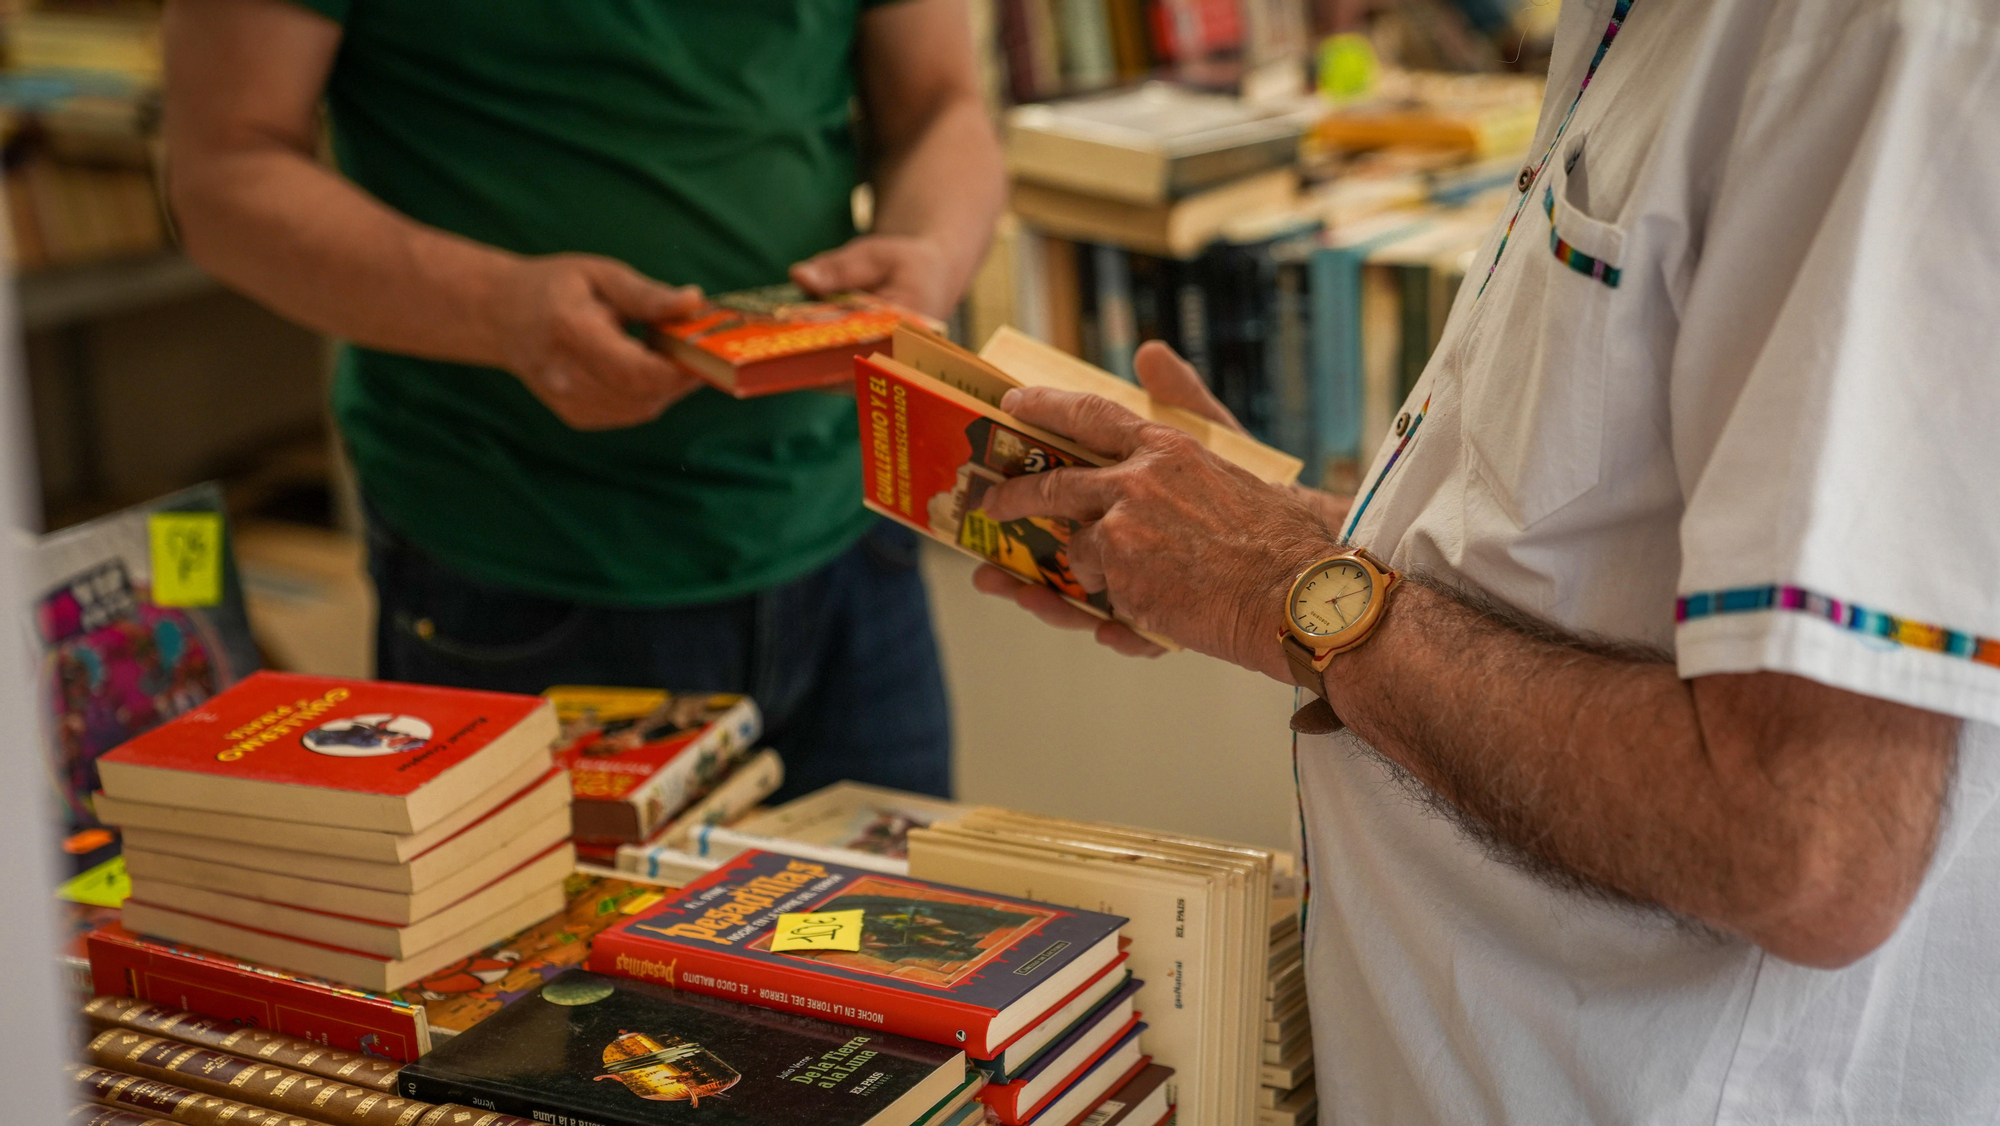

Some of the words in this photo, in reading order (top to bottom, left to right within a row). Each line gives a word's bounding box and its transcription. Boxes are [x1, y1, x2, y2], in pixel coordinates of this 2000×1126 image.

[869, 375, 888, 397] EL
[870, 394, 888, 409] Y
[893, 385, 910, 479] ENMASCARADO
[872, 411, 894, 505] GUILLERMO
[215, 687, 350, 762] GUILLERMO
[726, 924, 760, 942] NOCHE
[752, 916, 771, 928] EN
[773, 899, 804, 914] TORRE
[796, 890, 818, 902] DEL
[810, 873, 844, 893] TERROR
[1176, 898, 1186, 924] PAIS
[1175, 925, 1185, 938] EL
[682, 972, 715, 988] MALDITO
[716, 979, 738, 992] CUCO
[738, 983, 749, 994] EL
[759, 988, 789, 1003] TERROR
[791, 995, 805, 1007] DEL
[807, 999, 832, 1013] TORRE
[833, 1004, 844, 1014] LA
[844, 1007, 856, 1018] EN
[857, 1009, 884, 1024] NOCHE
[821, 1036, 871, 1062] Tierra
[776, 1065, 796, 1080] Julio
[790, 1055, 814, 1070] Verne
[808, 1062, 836, 1073] la
[834, 1049, 879, 1073] Luna
[790, 1071, 822, 1085] De
[830, 1071, 850, 1084] la
[849, 1085, 868, 1096] EL
[859, 1071, 885, 1088] PAIS
[408, 1082, 417, 1096] 40
[817, 1081, 836, 1090] a
[472, 1097, 496, 1111] Verne
[532, 1110, 556, 1126] Luna
[558, 1115, 568, 1126] la
